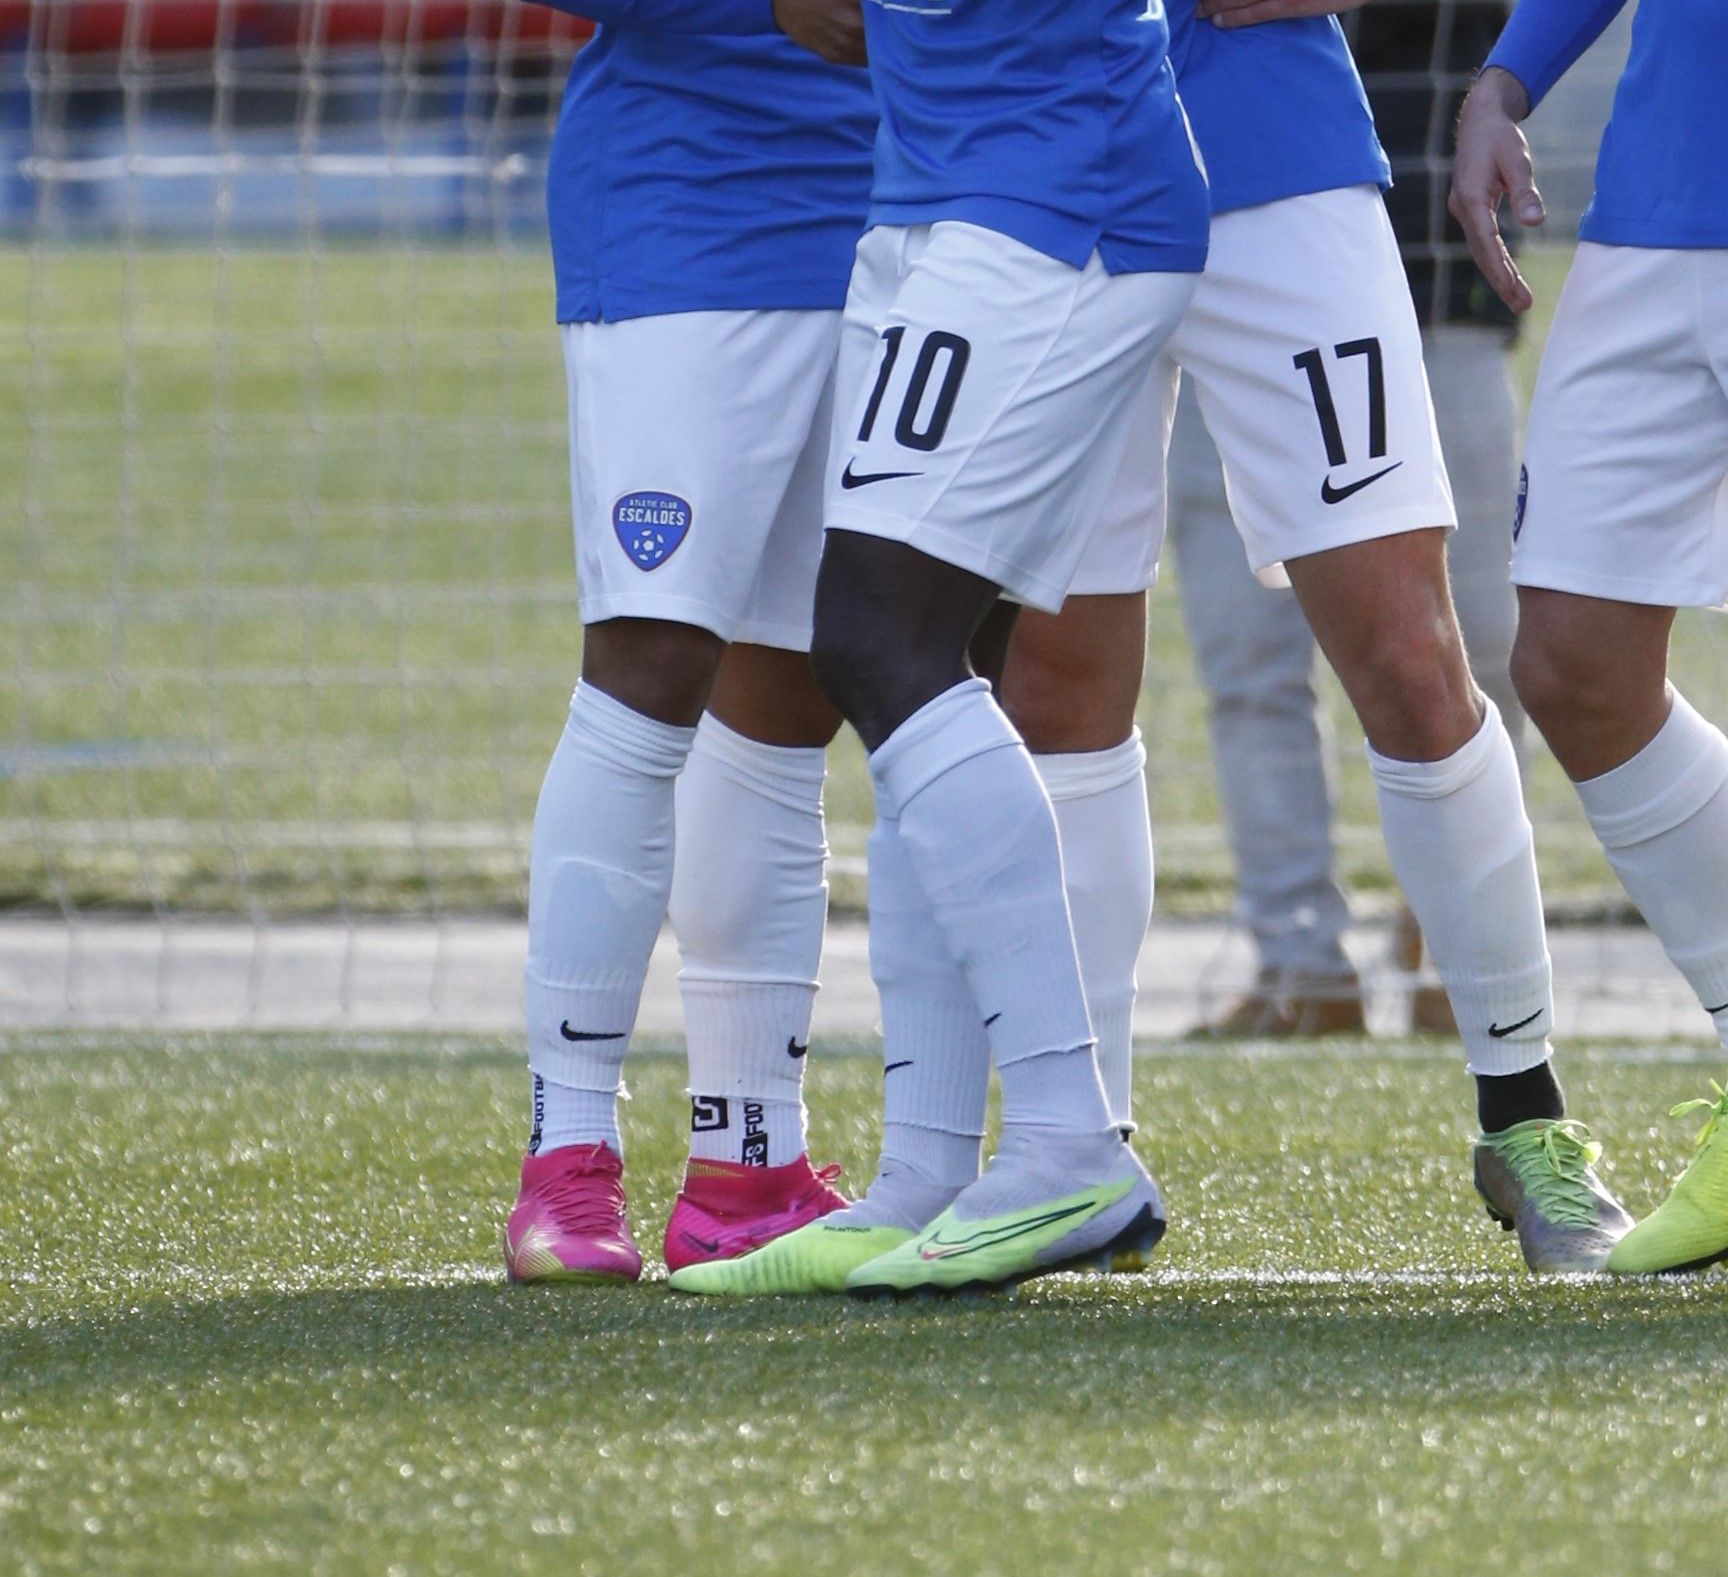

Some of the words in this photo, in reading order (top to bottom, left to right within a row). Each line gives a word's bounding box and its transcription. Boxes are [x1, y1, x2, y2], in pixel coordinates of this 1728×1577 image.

[857, 326, 971, 452] 10
[1293, 337, 1387, 467] 17
[619, 507, 685, 526] ESCALDES
